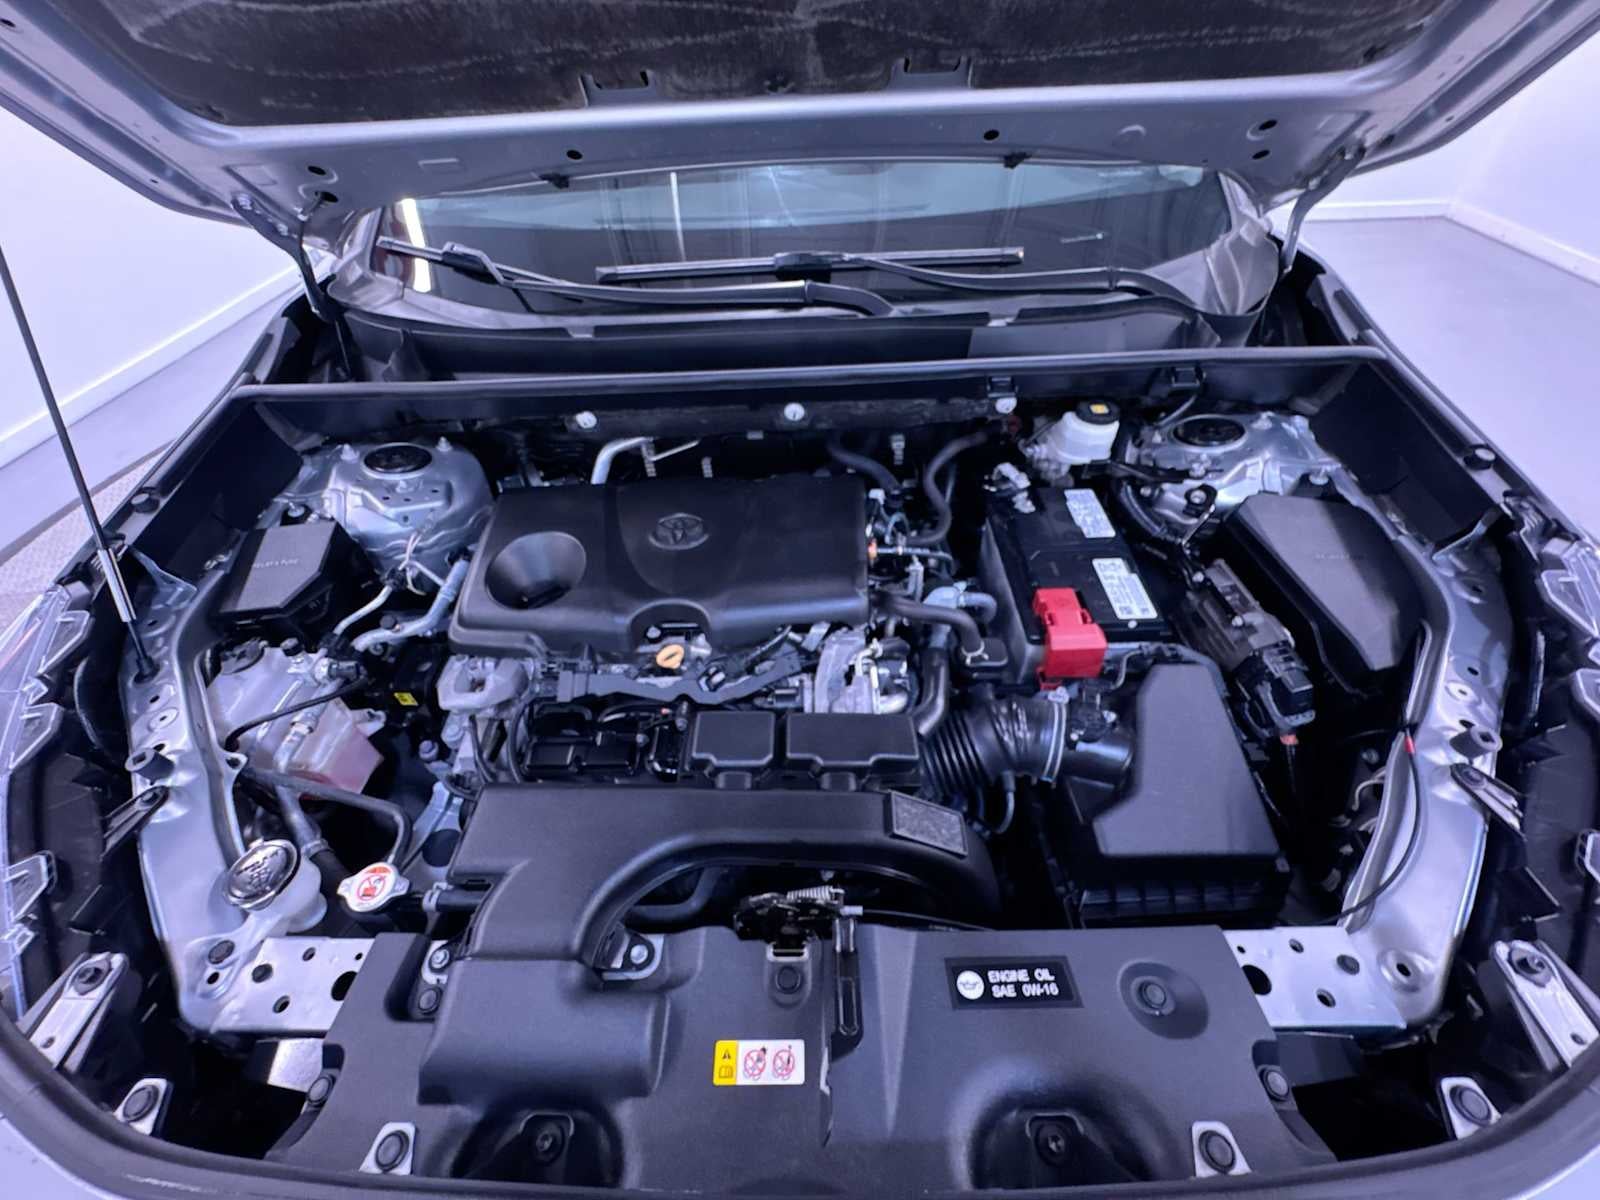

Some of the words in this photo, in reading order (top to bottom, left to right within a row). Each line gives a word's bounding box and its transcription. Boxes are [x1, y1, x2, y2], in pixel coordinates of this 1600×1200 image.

[987, 969, 1030, 983] ENGINE
[1034, 968, 1055, 982] OIL
[991, 984, 1017, 998] SAE
